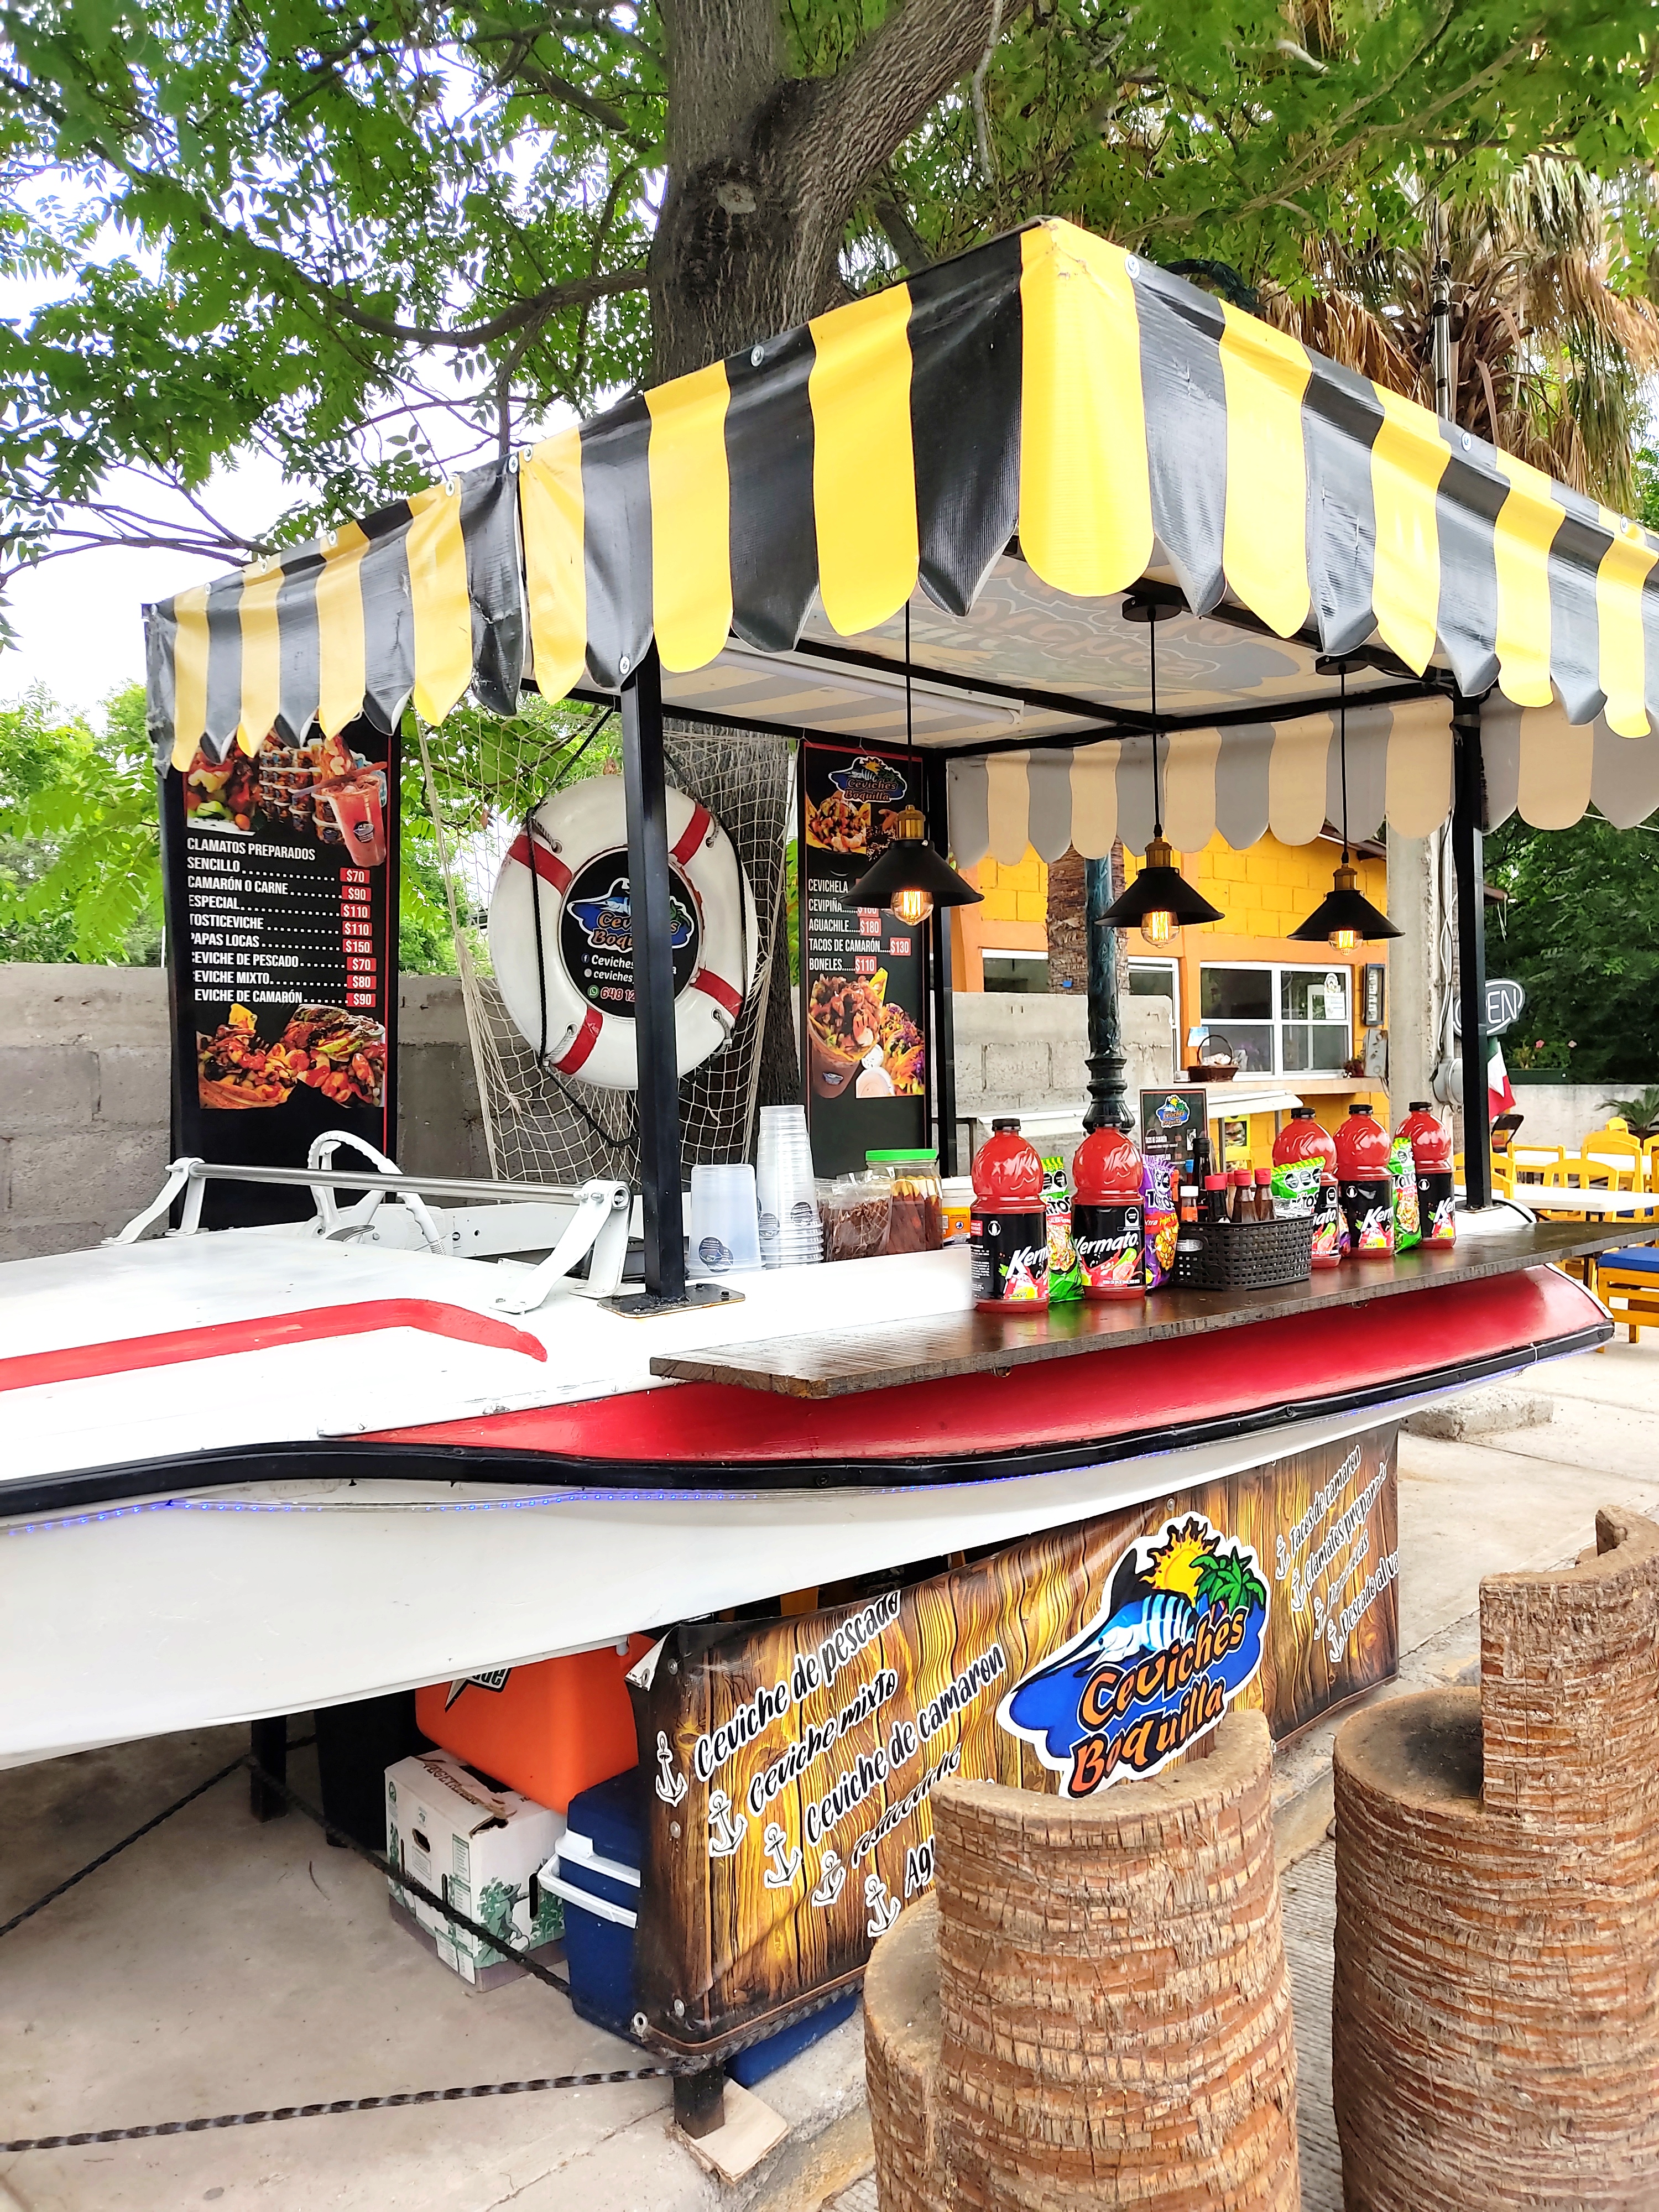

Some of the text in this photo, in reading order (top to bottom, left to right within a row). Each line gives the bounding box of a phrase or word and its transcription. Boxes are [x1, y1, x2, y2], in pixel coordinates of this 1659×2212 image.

[847, 778, 898, 790] Ceviches
[845, 789, 890, 801] Boquilla
[187, 837, 316, 860] CLAMATOS PREPARADOS
[187, 857, 365, 883] SENCILLO $70
[187, 875, 366, 901] CAMARÓN O CARNE $90
[808, 878, 848, 894] CEVICHELA
[189, 894, 368, 918] ESPECIAL $110
[808, 898, 843, 912] CEVIPIÑA
[189, 913, 369, 935] TOSTICEVICHE $110
[808, 918, 879, 934] AGUACHILE $180
[225, 934, 260, 948] LOCAS
[346, 940, 370, 953] $150
[808, 937, 909, 953] TACOS DE CAMARÓN $130
[192, 951, 371, 971] EVICHE DE PESCADO $70
[809, 957, 875, 972] BONELES $110
[192, 970, 371, 988] EVICHE MIXTO $80
[194, 989, 372, 1006] EVICHE DE CAMARÓN $90
[601, 987, 623, 1000] 648
[1290, 1447, 1361, 1556] Tacos de camaron
[1378, 1558, 1387, 1589] al
[1081, 1609, 1246, 1729] Ceviches
[697, 1590, 901, 1778] Ceviche de pescado
[806, 1646, 1004, 1844] Ceviche de camaron
[1070, 1678, 1224, 1796] Boquilla
[750, 1721, 836, 1813] Ceviche
